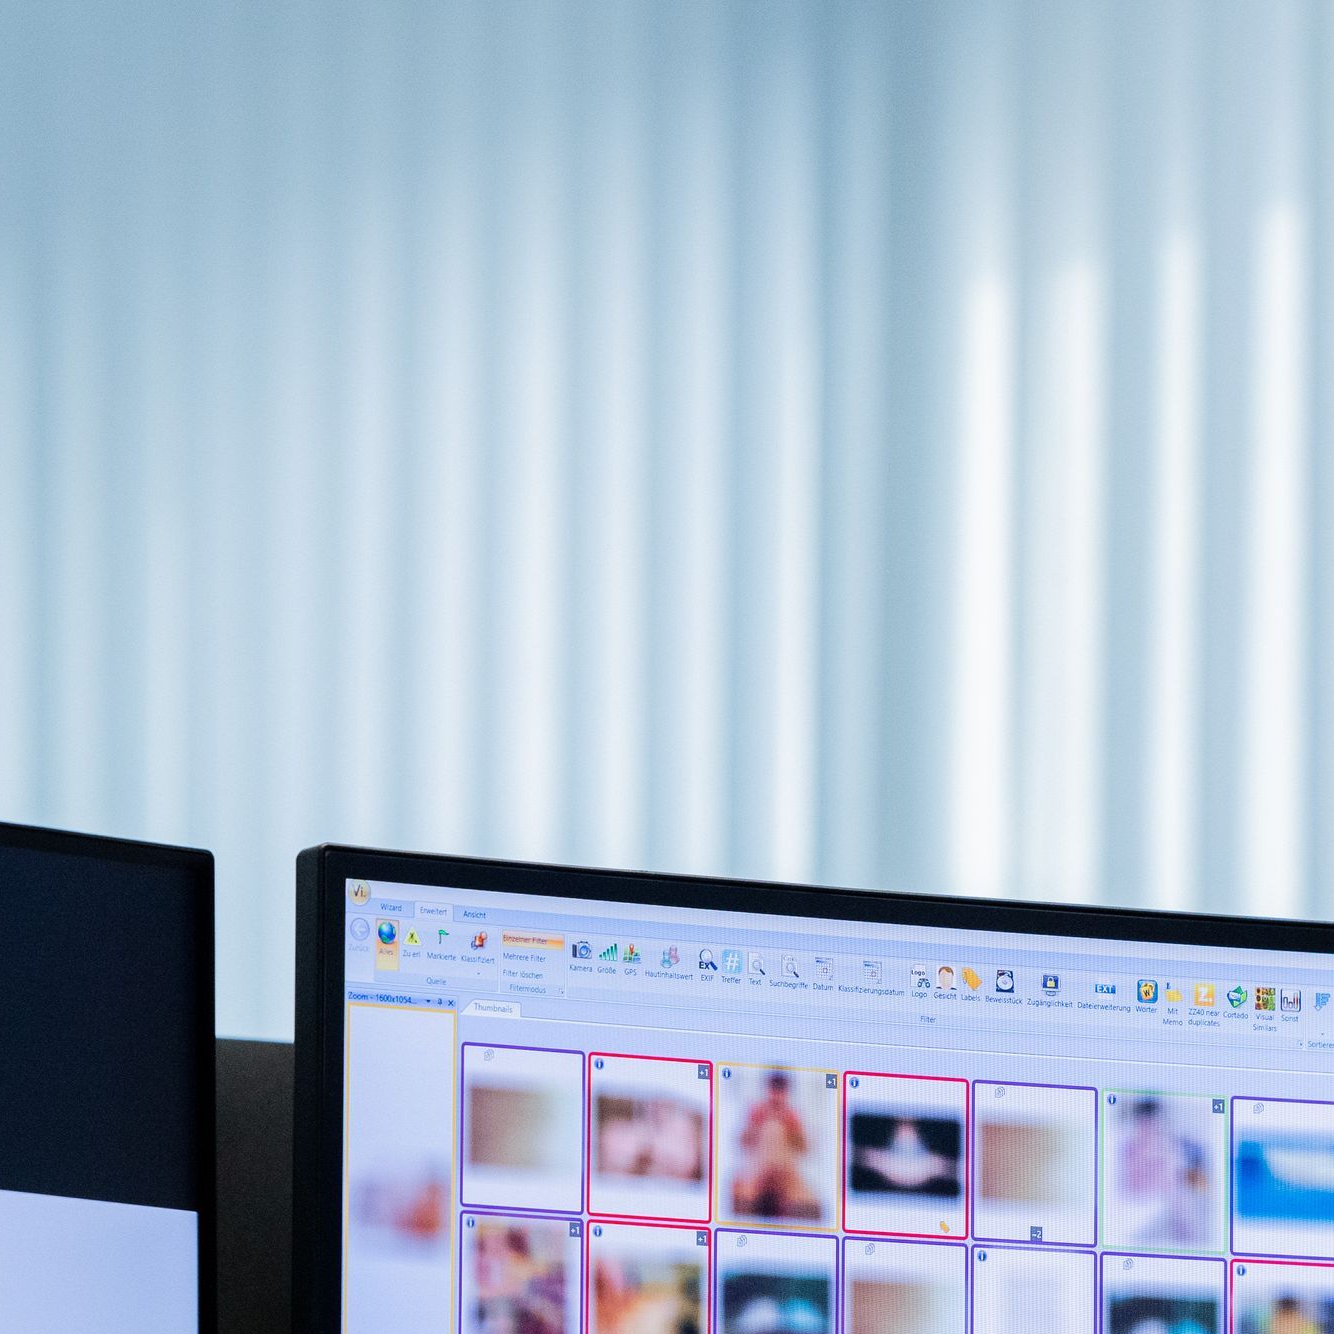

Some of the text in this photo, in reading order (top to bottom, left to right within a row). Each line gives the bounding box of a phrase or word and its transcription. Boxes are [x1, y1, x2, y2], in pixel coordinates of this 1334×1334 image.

[380, 903, 402, 912] Wizard
[420, 906, 447, 916] Erweitert
[463, 910, 486, 919] Ansicht
[503, 934, 548, 945] Einzelner Filter
[427, 952, 457, 961] Markierte
[461, 955, 495, 964] Klassifiziert
[503, 952, 546, 963] Mehrere Filter
[569, 964, 593, 973] Kamera
[597, 966, 617, 975] Größe
[624, 968, 637, 976] GPS
[503, 969, 543, 979] Filter löschen
[700, 974, 714, 982] EXIF
[427, 977, 447, 985] Quelle
[721, 975, 742, 985] Treffer
[749, 977, 762, 986] Text
[769, 979, 808, 990] Suchbegriffe
[509, 984, 546, 994] Filtermodus
[813, 982, 834, 992] Datum
[838, 984, 905, 997] Klassifizierungsdatum
[348, 992, 368, 1000] Zoom
[912, 990, 927, 999] Logo
[933, 991, 957, 1001] Gesicht
[961, 993, 981, 1002] Labels
[985, 995, 1022, 1006] Beweisstück
[1027, 998, 1073, 1009] Zugänglichkeit
[474, 1002, 513, 1013] Thumbnails
[1077, 1001, 1131, 1013] Dateierweiterung
[920, 1015, 936, 1024] Filter
[1223, 1010, 1249, 1020] Cortado
[1256, 1013, 1275, 1021] Visual
[1162, 1018, 1183, 1027] Memo
[1188, 1018, 1220, 1028] duplicates
